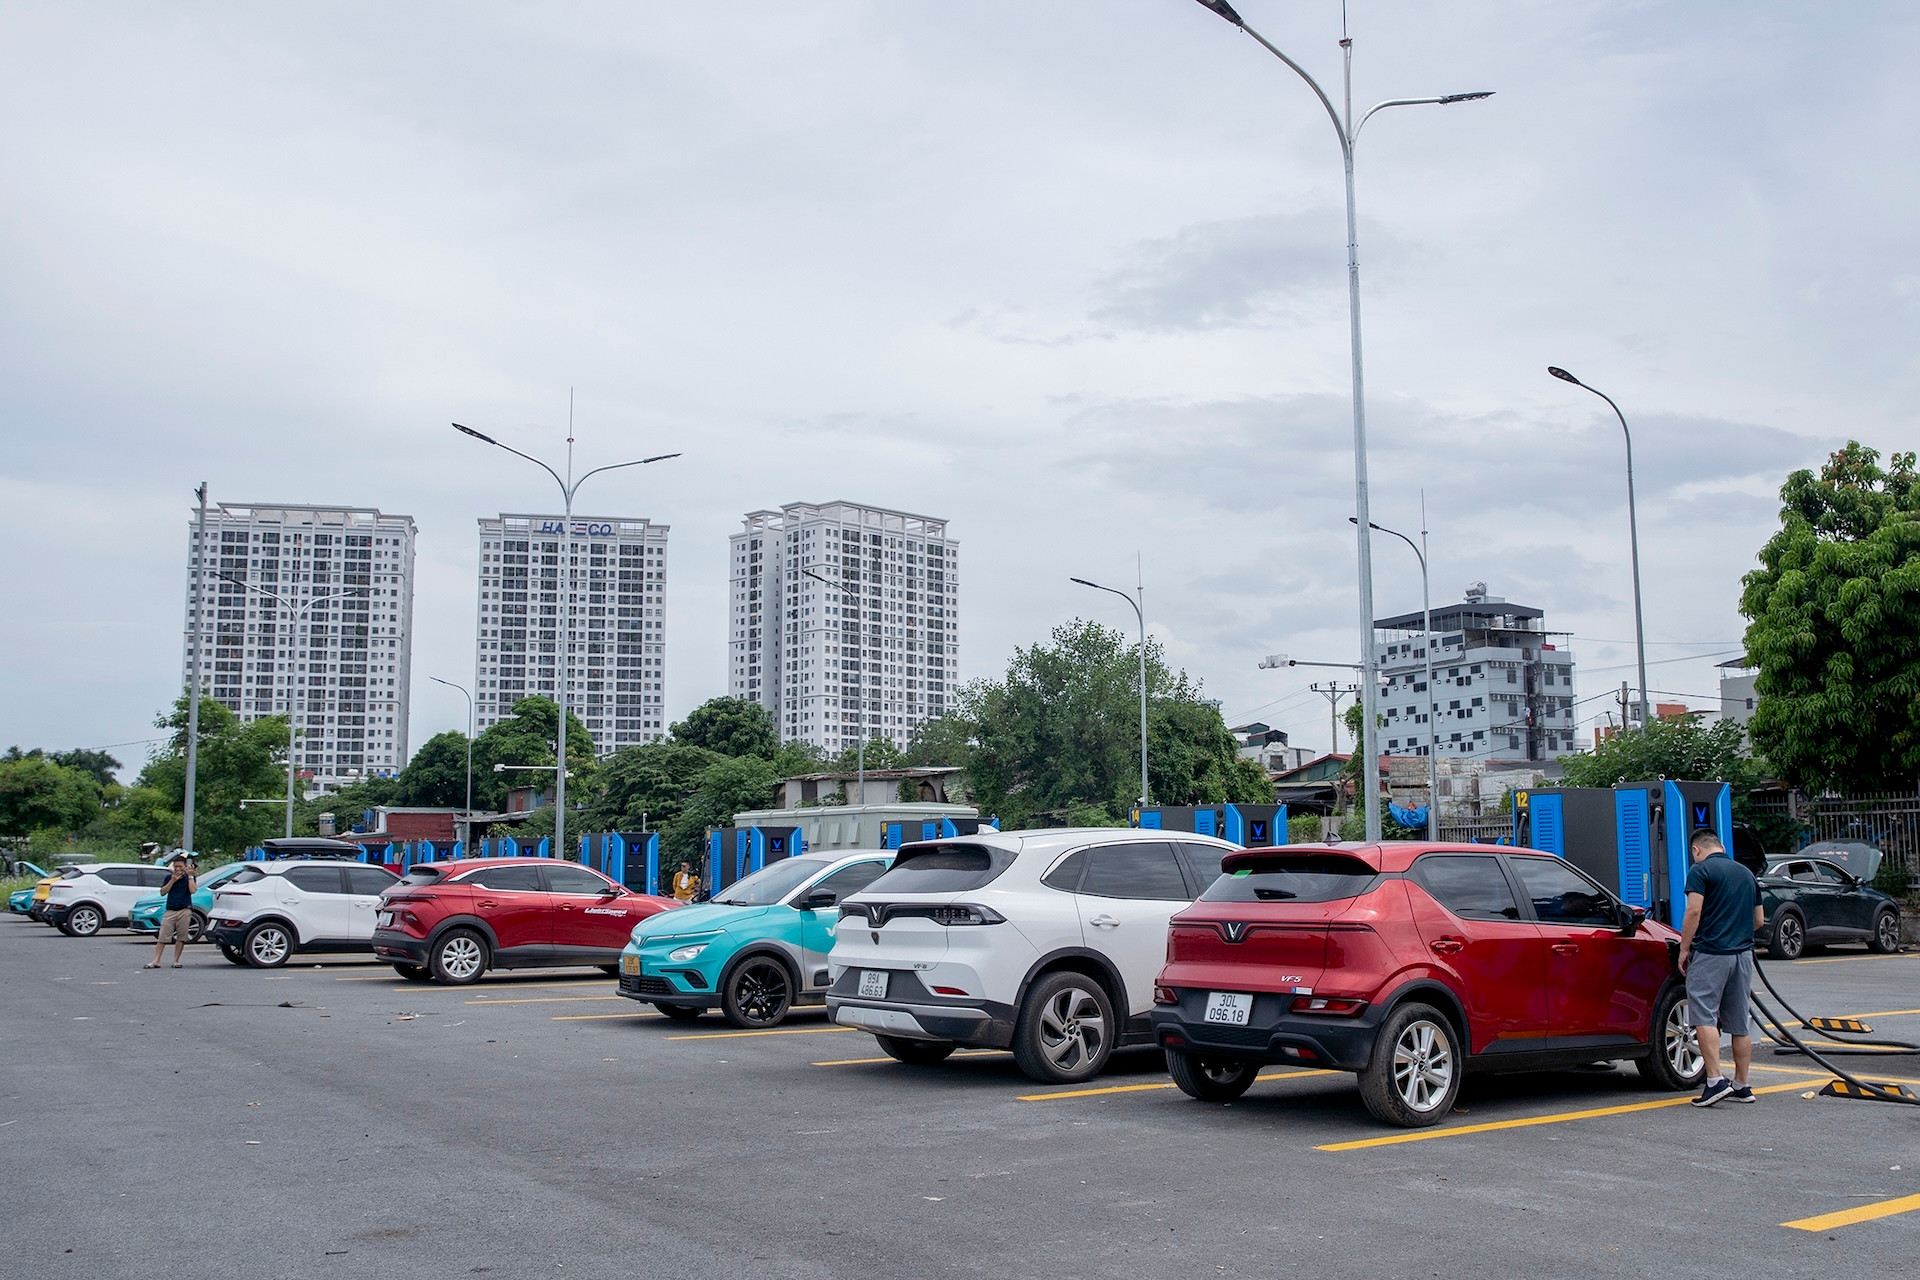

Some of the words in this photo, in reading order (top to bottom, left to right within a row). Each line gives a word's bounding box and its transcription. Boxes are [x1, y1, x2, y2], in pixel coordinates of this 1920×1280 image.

[541, 521, 612, 536] HAECO
[1515, 791, 1528, 808] 12
[1131, 809, 1140, 822] 14
[867, 973, 880, 984] 89A
[861, 985, 883, 997] 486.63
[1219, 994, 1237, 1008] 30L
[1209, 1007, 1244, 1022] 096.18
